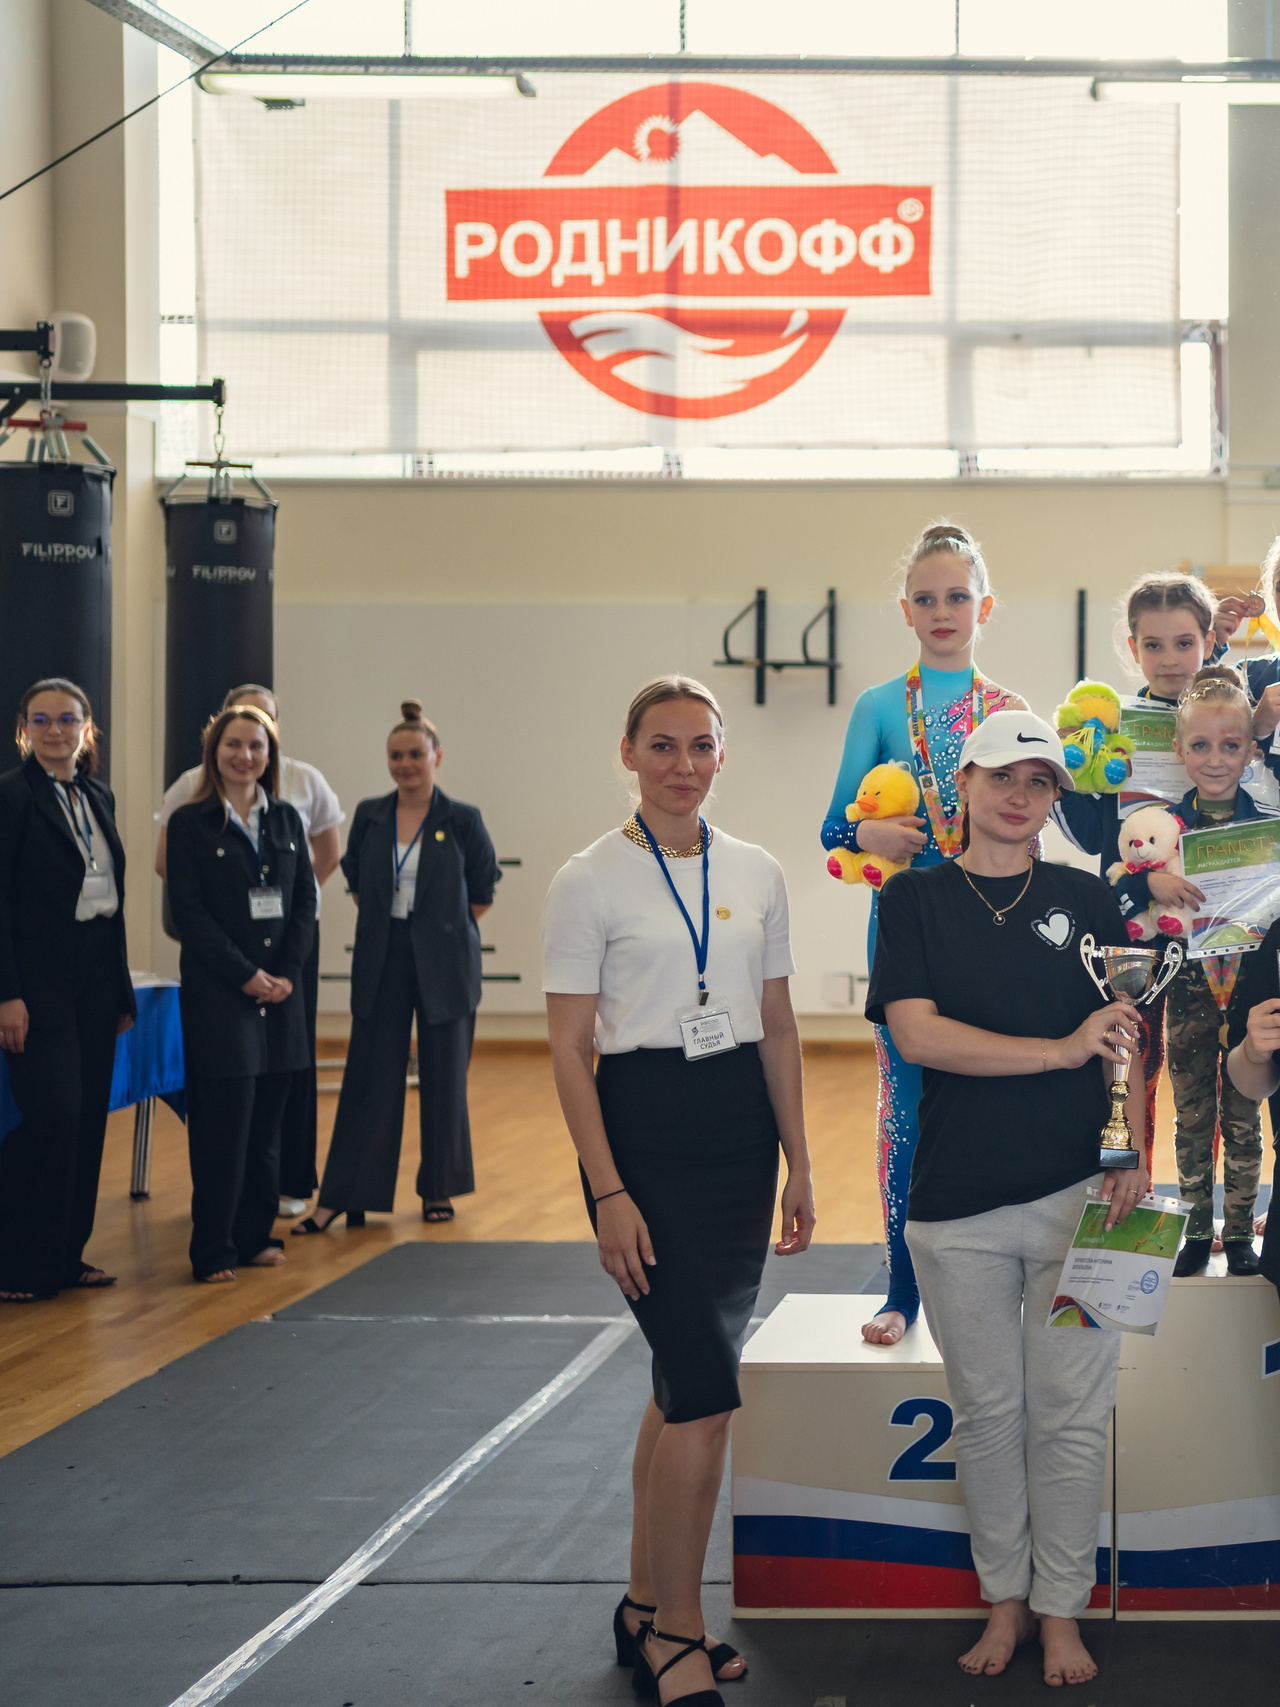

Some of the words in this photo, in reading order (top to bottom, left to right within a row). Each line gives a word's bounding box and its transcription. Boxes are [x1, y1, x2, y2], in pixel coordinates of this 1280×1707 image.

[454, 216, 916, 287] РОДНИКОФФ
[21, 543, 97, 559] FILIPPOV
[192, 565, 257, 581] FILIPPOV
[1133, 724, 1174, 738] ГРАМ
[1196, 835, 1278, 859] ГРАМОТА
[693, 1032, 724, 1045] ГЛАВНЫЙ
[700, 1040, 721, 1049] СУДЬЯ
[887, 1396, 958, 1482] 2
